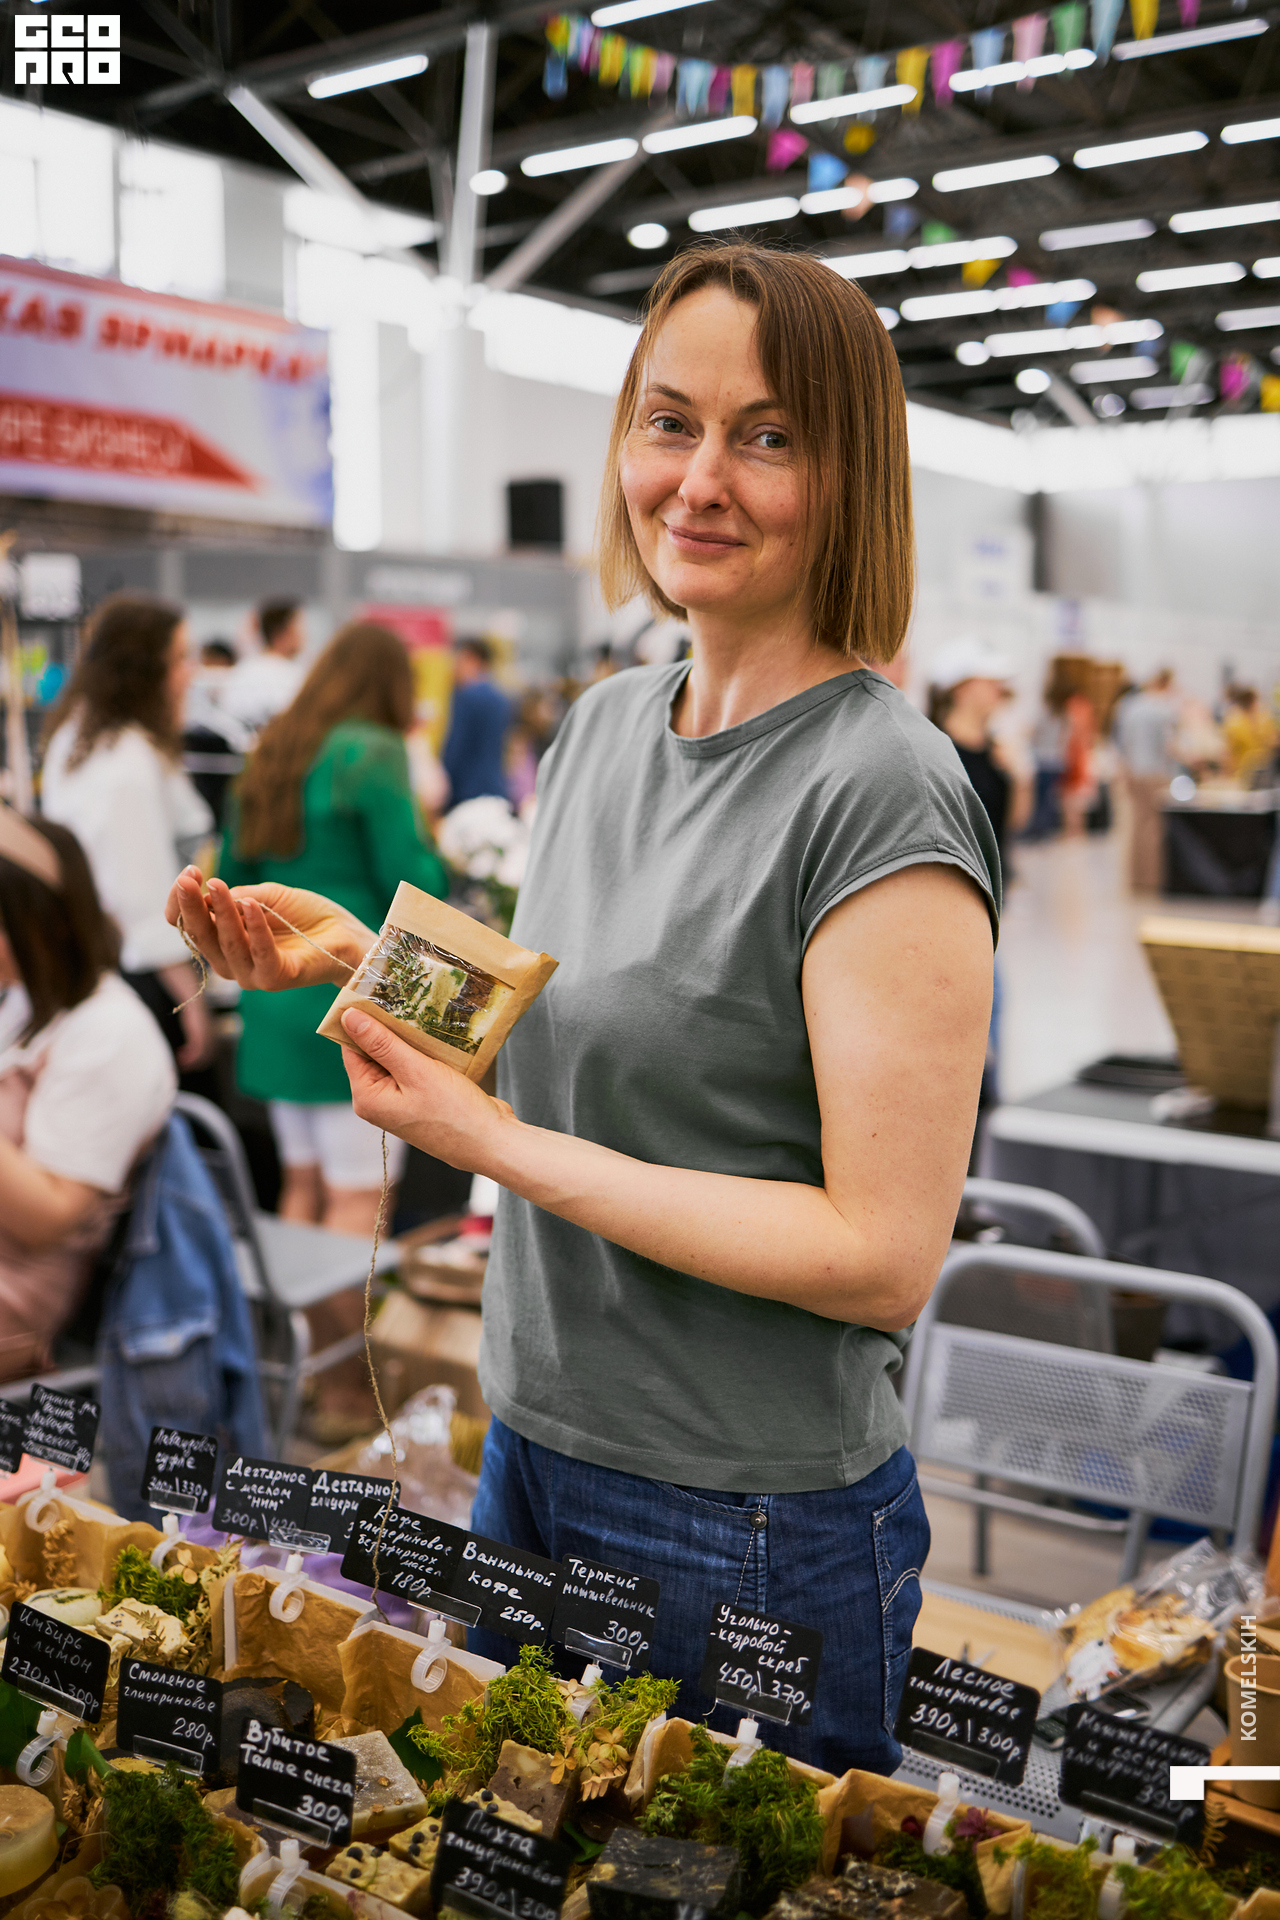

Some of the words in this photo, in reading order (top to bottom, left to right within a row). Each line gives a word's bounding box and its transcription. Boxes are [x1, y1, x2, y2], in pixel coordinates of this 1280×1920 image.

[155, 1451, 197, 1472] суфле
[227, 1457, 307, 1486] Дегтярное
[225, 1480, 235, 1490] с
[240, 1484, 292, 1499] маслом
[374, 1504, 422, 1532] Кофе
[359, 1520, 452, 1556] глицериновое
[462, 1541, 557, 1587] Ванильный
[569, 1558, 640, 1591] Терпкий
[20, 1608, 82, 1650] Имбирь
[500, 1606, 545, 1631] 250р.
[602, 1620, 649, 1655] 300р
[34, 1641, 92, 1674] лимон
[758, 1655, 809, 1673] скраб
[934, 1658, 1015, 1698] Лесное
[124, 1686, 216, 1712] глицериновое
[909, 1676, 1021, 1719] глицериновое
[246, 1719, 330, 1762] Взбитое
[304, 1769, 353, 1797] снега
[297, 1794, 349, 1832] 300р
[466, 1809, 534, 1858] Пихта
